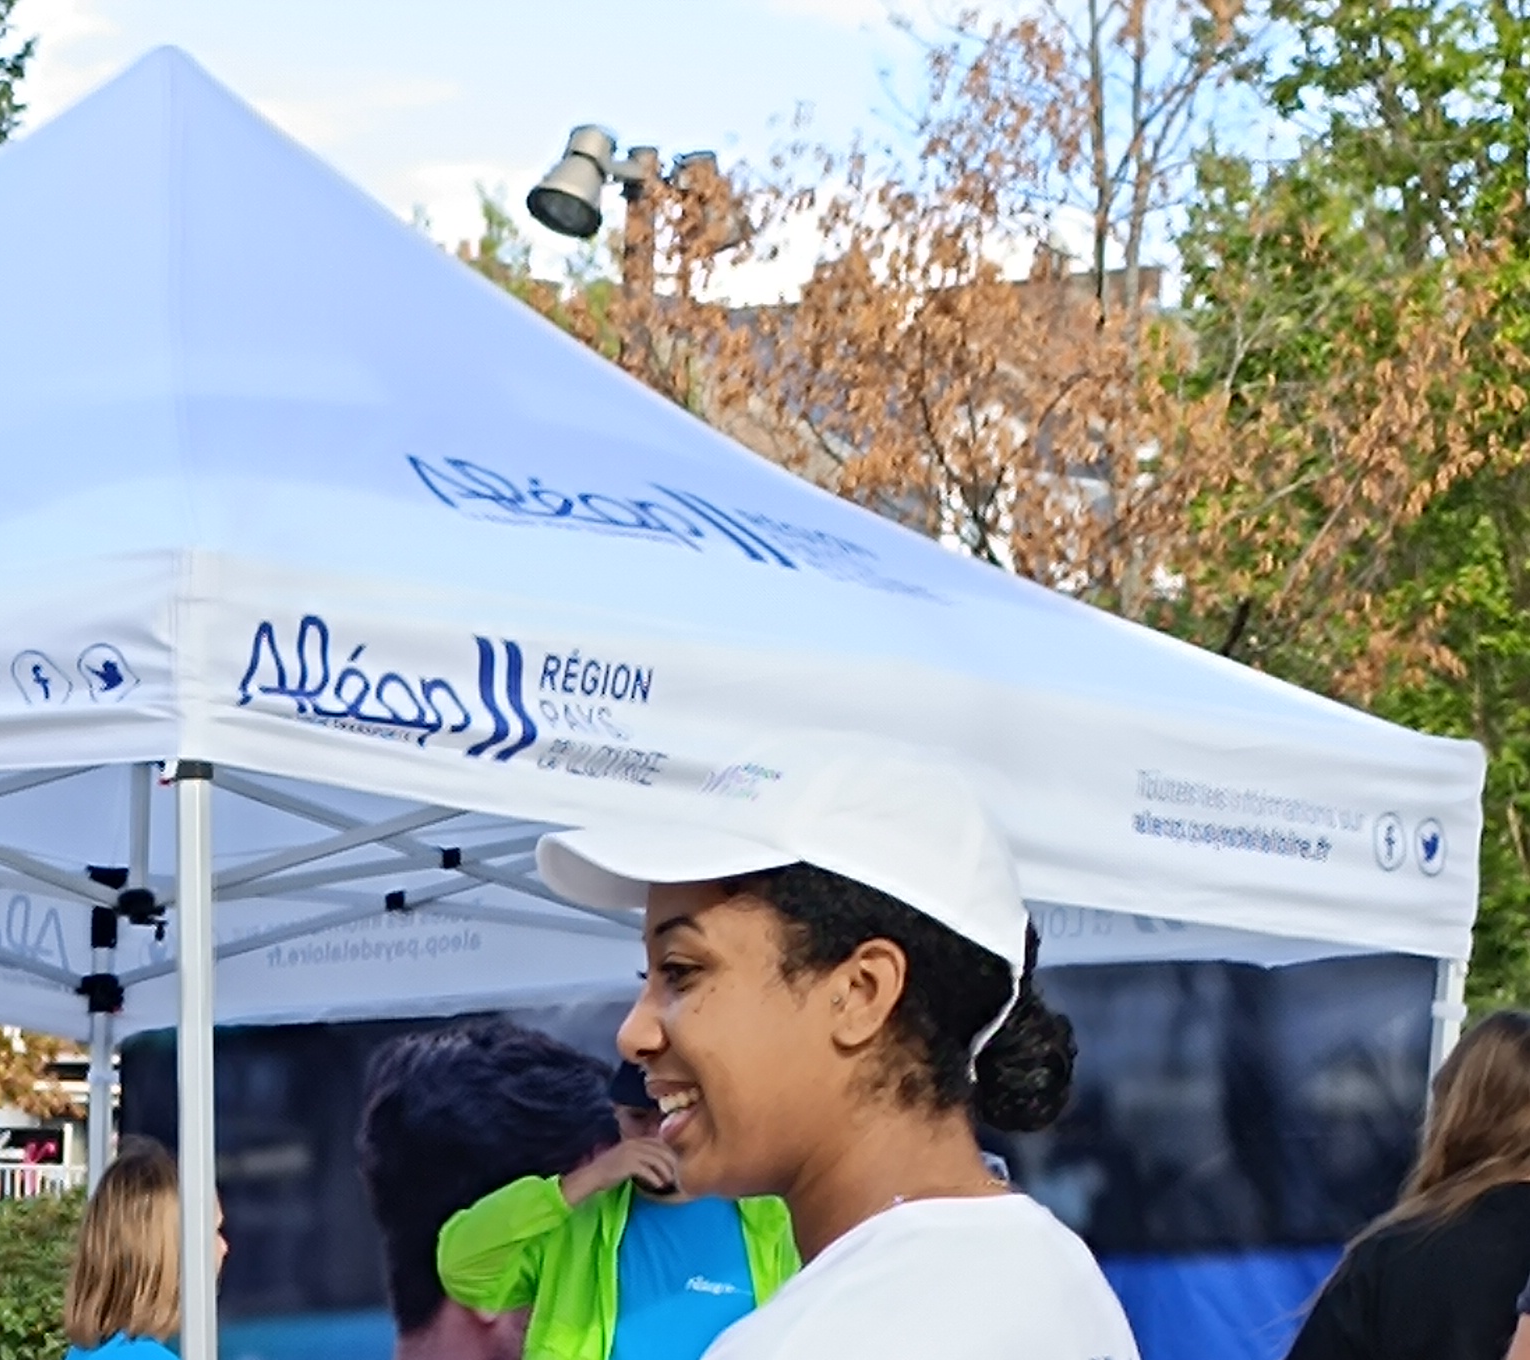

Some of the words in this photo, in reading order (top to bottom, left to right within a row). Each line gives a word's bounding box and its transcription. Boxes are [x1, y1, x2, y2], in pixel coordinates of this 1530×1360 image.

[237, 614, 471, 747] Aléop
[538, 648, 655, 704] RÉGION
[538, 698, 632, 742] PAYS
